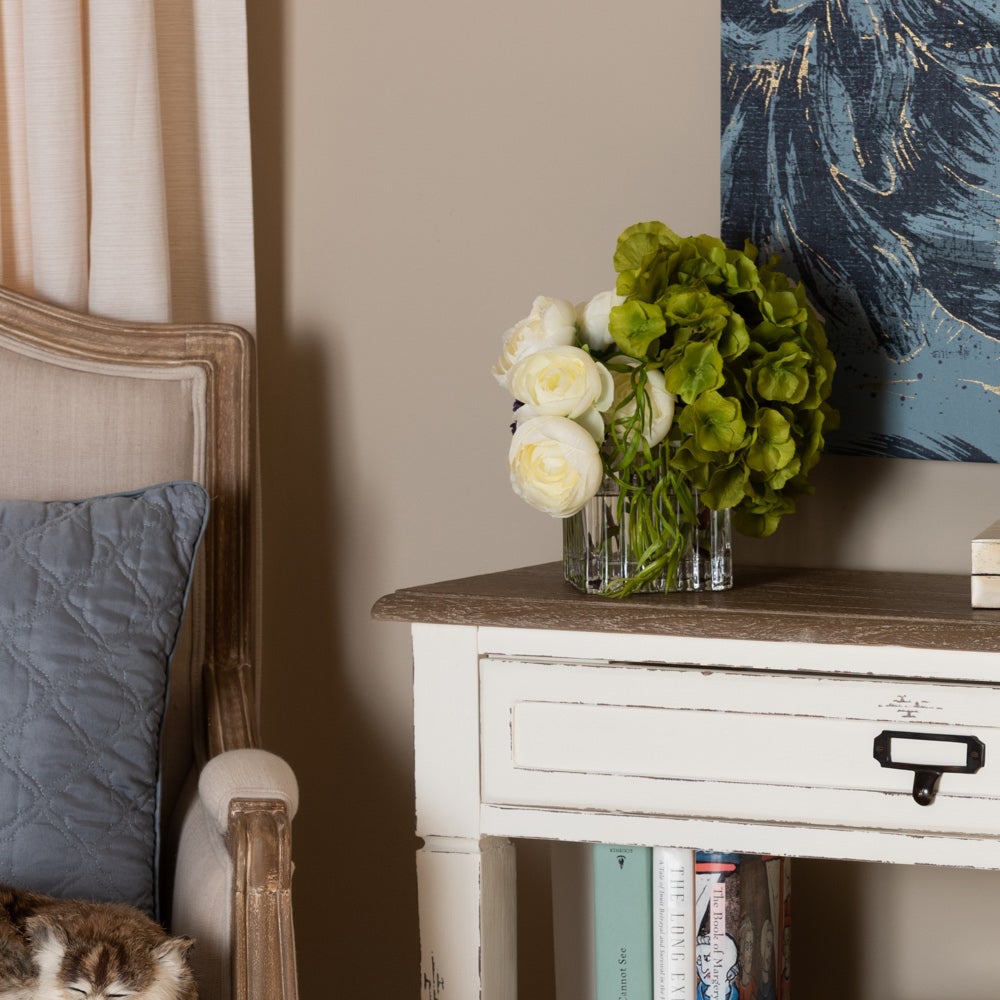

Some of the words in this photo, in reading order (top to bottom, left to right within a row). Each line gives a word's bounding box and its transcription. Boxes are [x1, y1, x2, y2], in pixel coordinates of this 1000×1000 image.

[671, 866, 685, 902] THE
[712, 888, 724, 908] The
[671, 914, 685, 960] LONG
[712, 912, 724, 939] Book
[617, 947, 627, 965] See
[712, 943, 724, 954] of
[710, 958, 723, 1000] Margery
